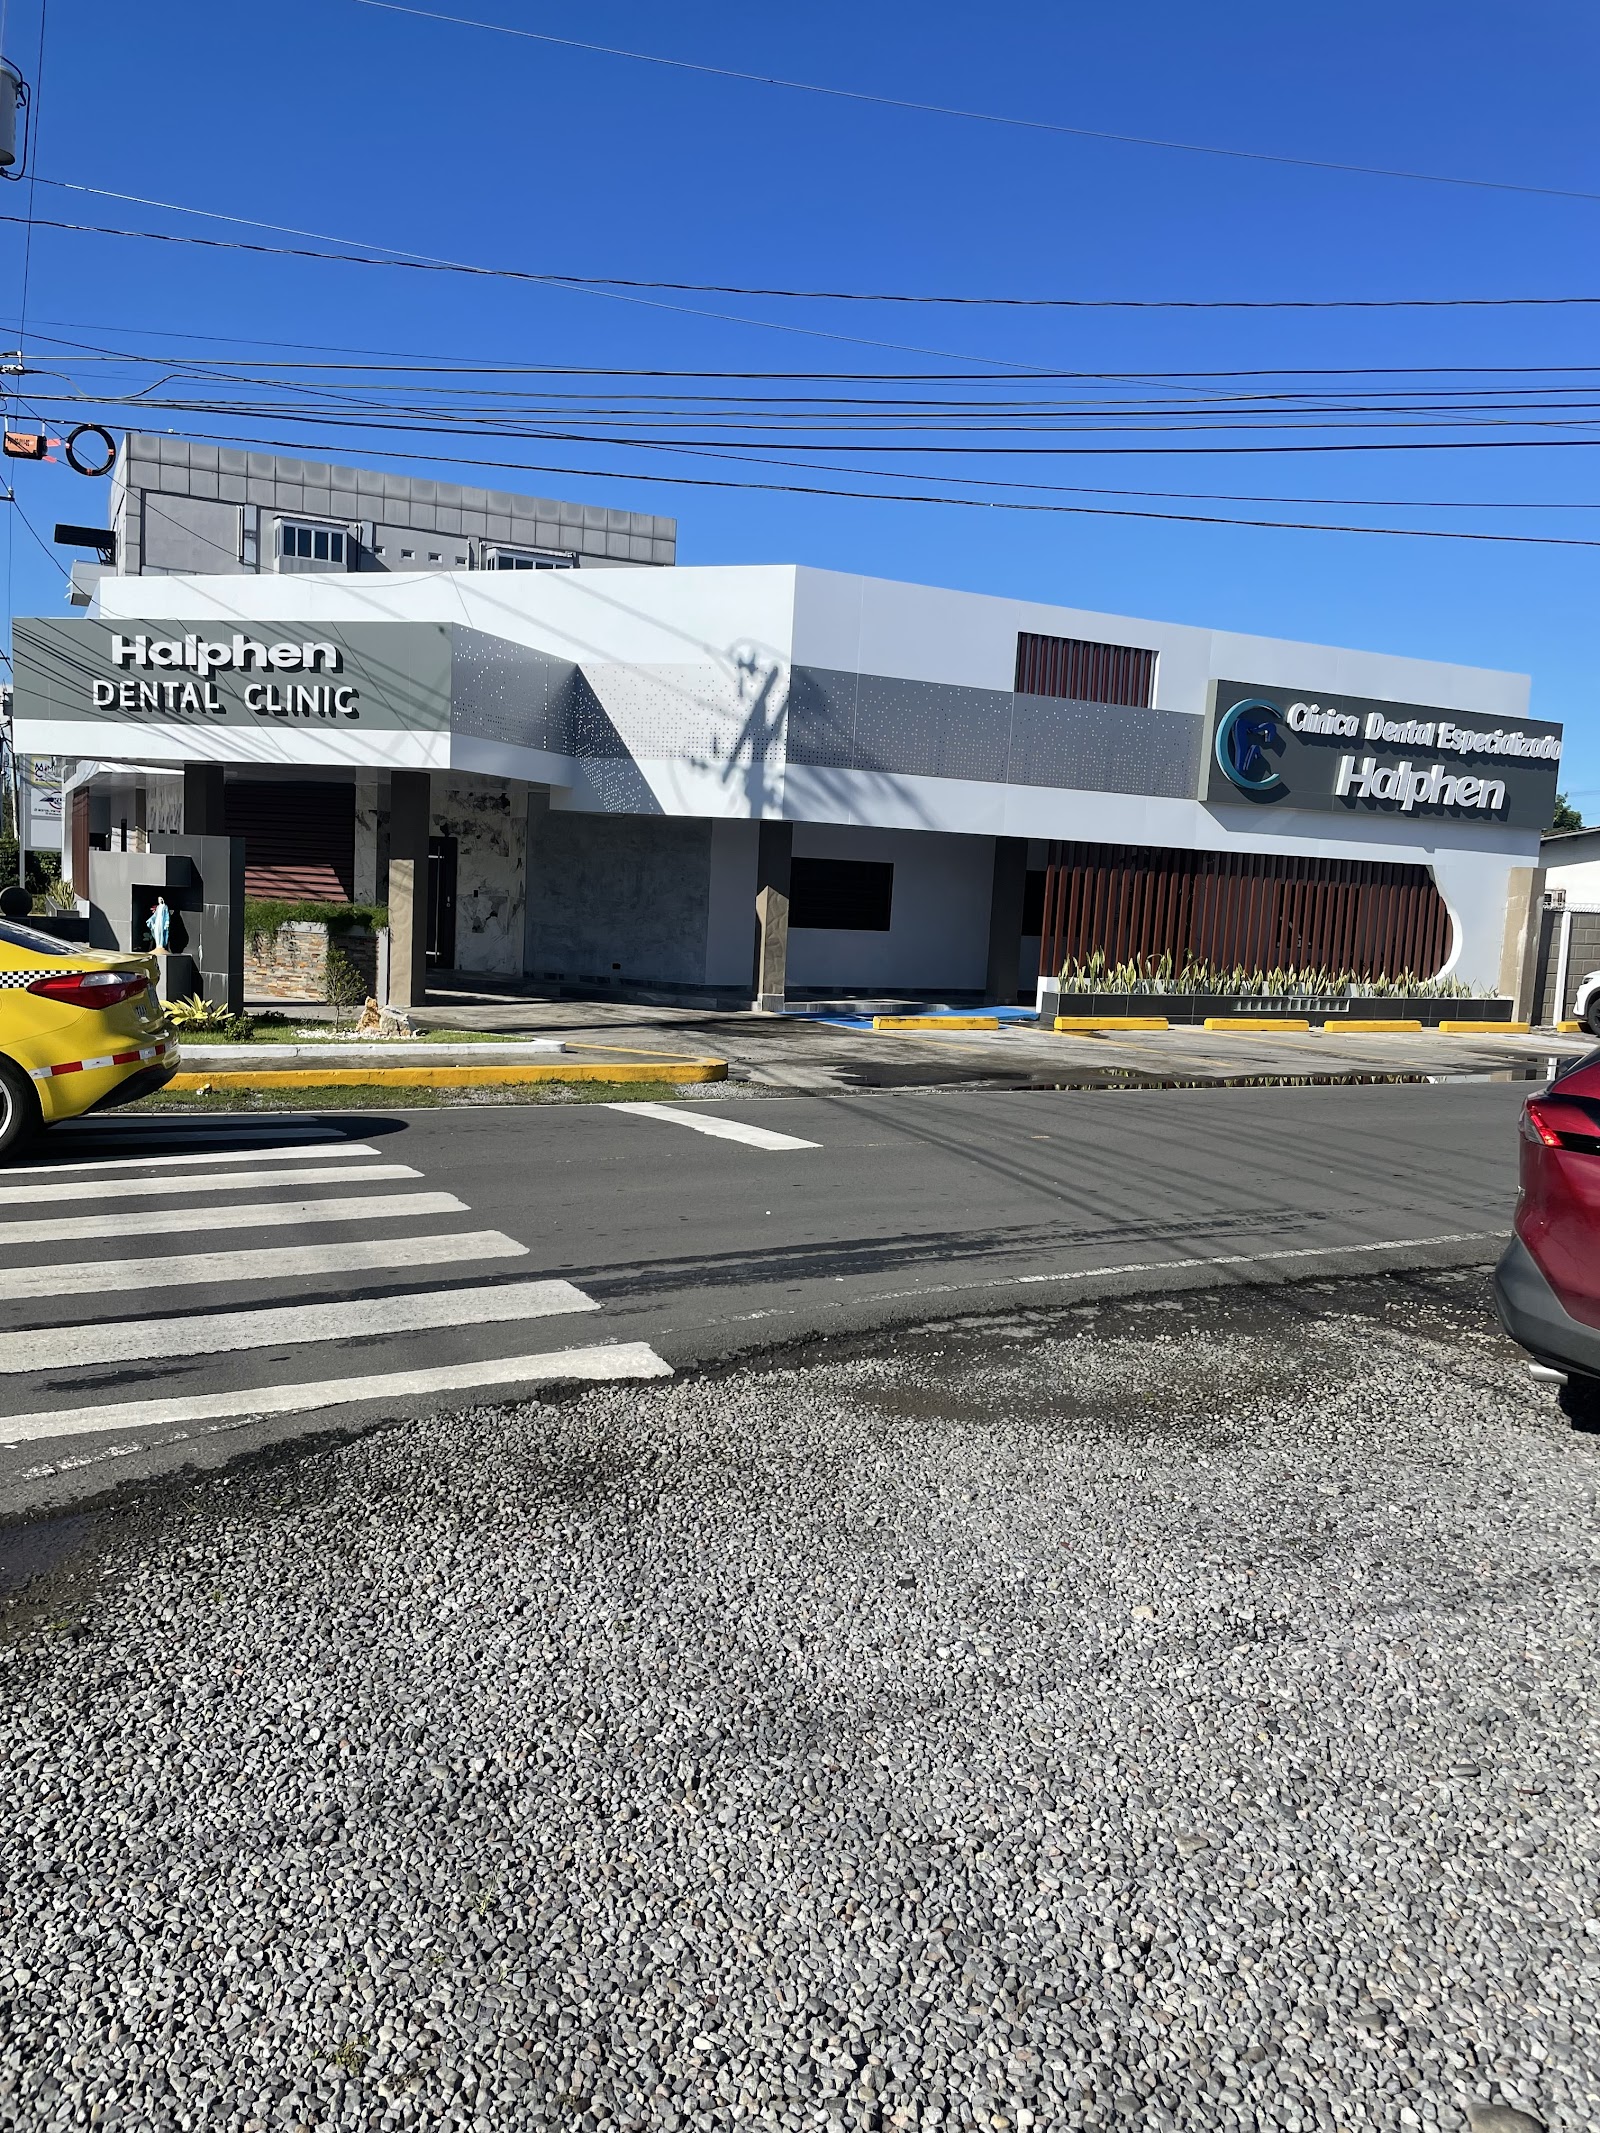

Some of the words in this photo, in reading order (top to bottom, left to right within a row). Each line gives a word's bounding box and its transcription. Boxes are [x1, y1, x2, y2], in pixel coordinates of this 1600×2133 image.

[111, 634, 338, 675] Halphen
[92, 679, 221, 710] DENTAL
[244, 684, 355, 714] CLINIC
[1287, 702, 1360, 737] Clínica
[1364, 712, 1436, 747] Dental
[1437, 722, 1562, 760] Especializada
[1335, 754, 1506, 811] Halphen
